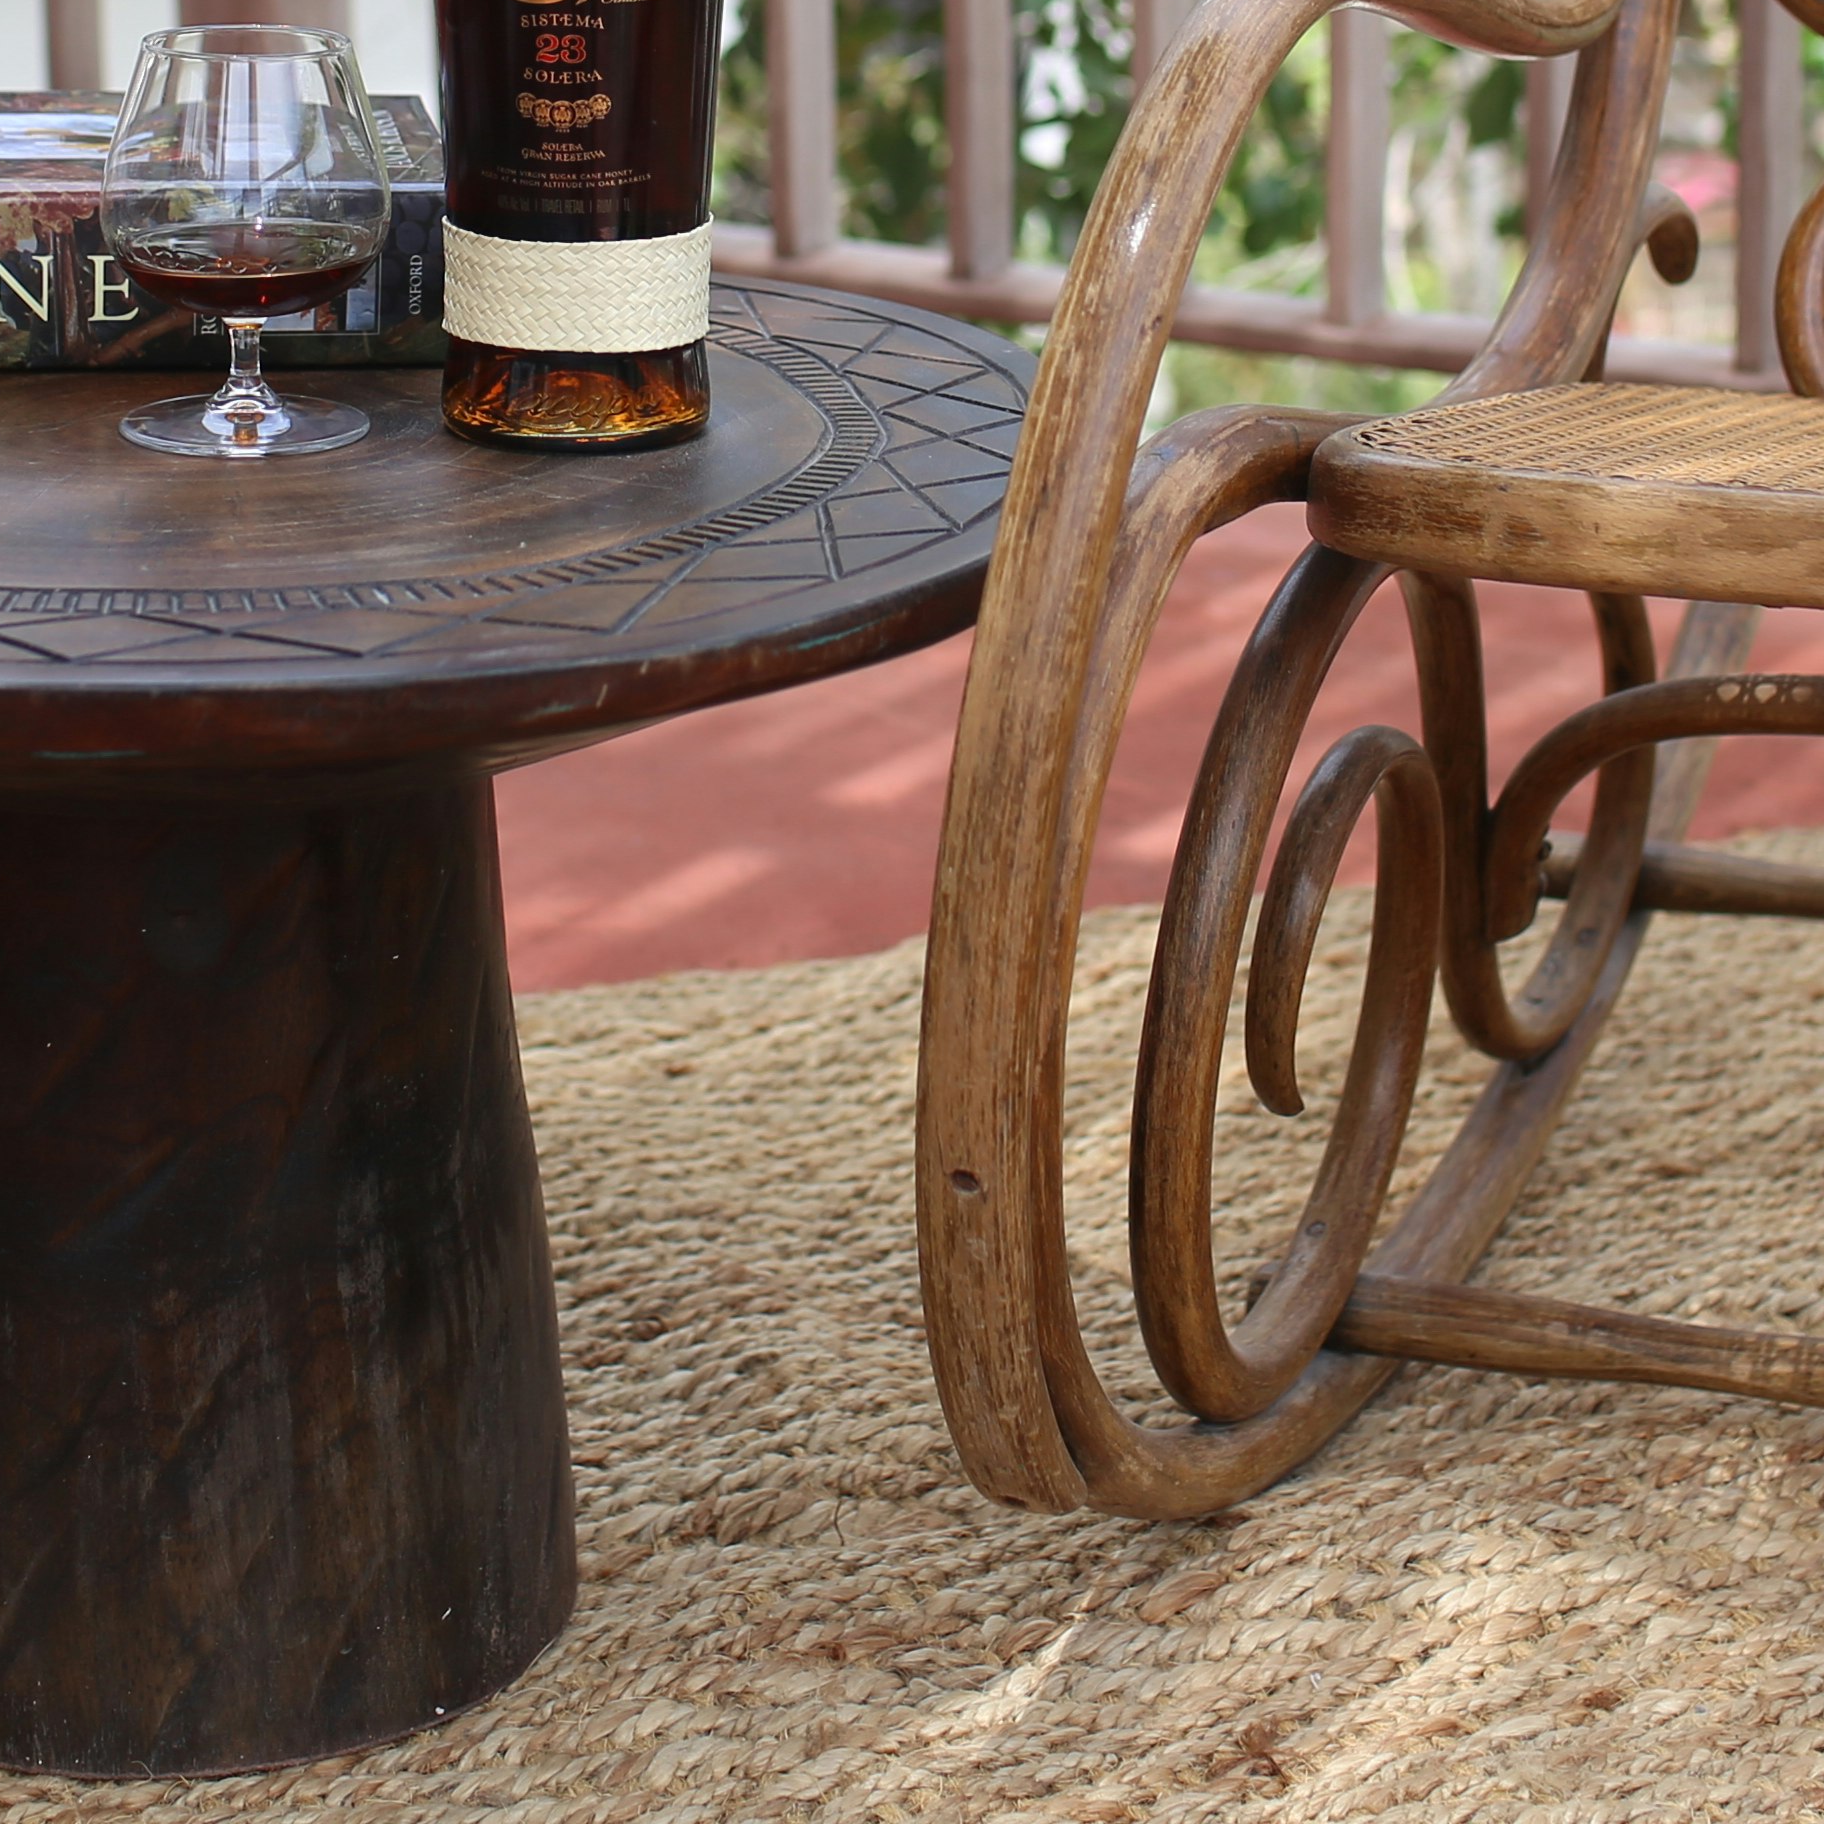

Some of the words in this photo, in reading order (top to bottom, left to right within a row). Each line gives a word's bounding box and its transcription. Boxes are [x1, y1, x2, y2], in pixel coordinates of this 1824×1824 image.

[520, 13, 605, 30] SISTEMA
[536, 33, 587, 64] 23
[523, 67, 603, 85] SOLERA
[521, 147, 553, 161] GRAN
[554, 149, 606, 162] RESERVA
[541, 142, 584, 152] SOLERA
[549, 171, 578, 180] SUGAR
[580, 171, 602, 180] CANE
[604, 169, 634, 179] HONEY
[543, 180, 583, 189] ALTITUDE
[585, 180, 596, 188] IN
[408, 254, 423, 315] OXFORD
